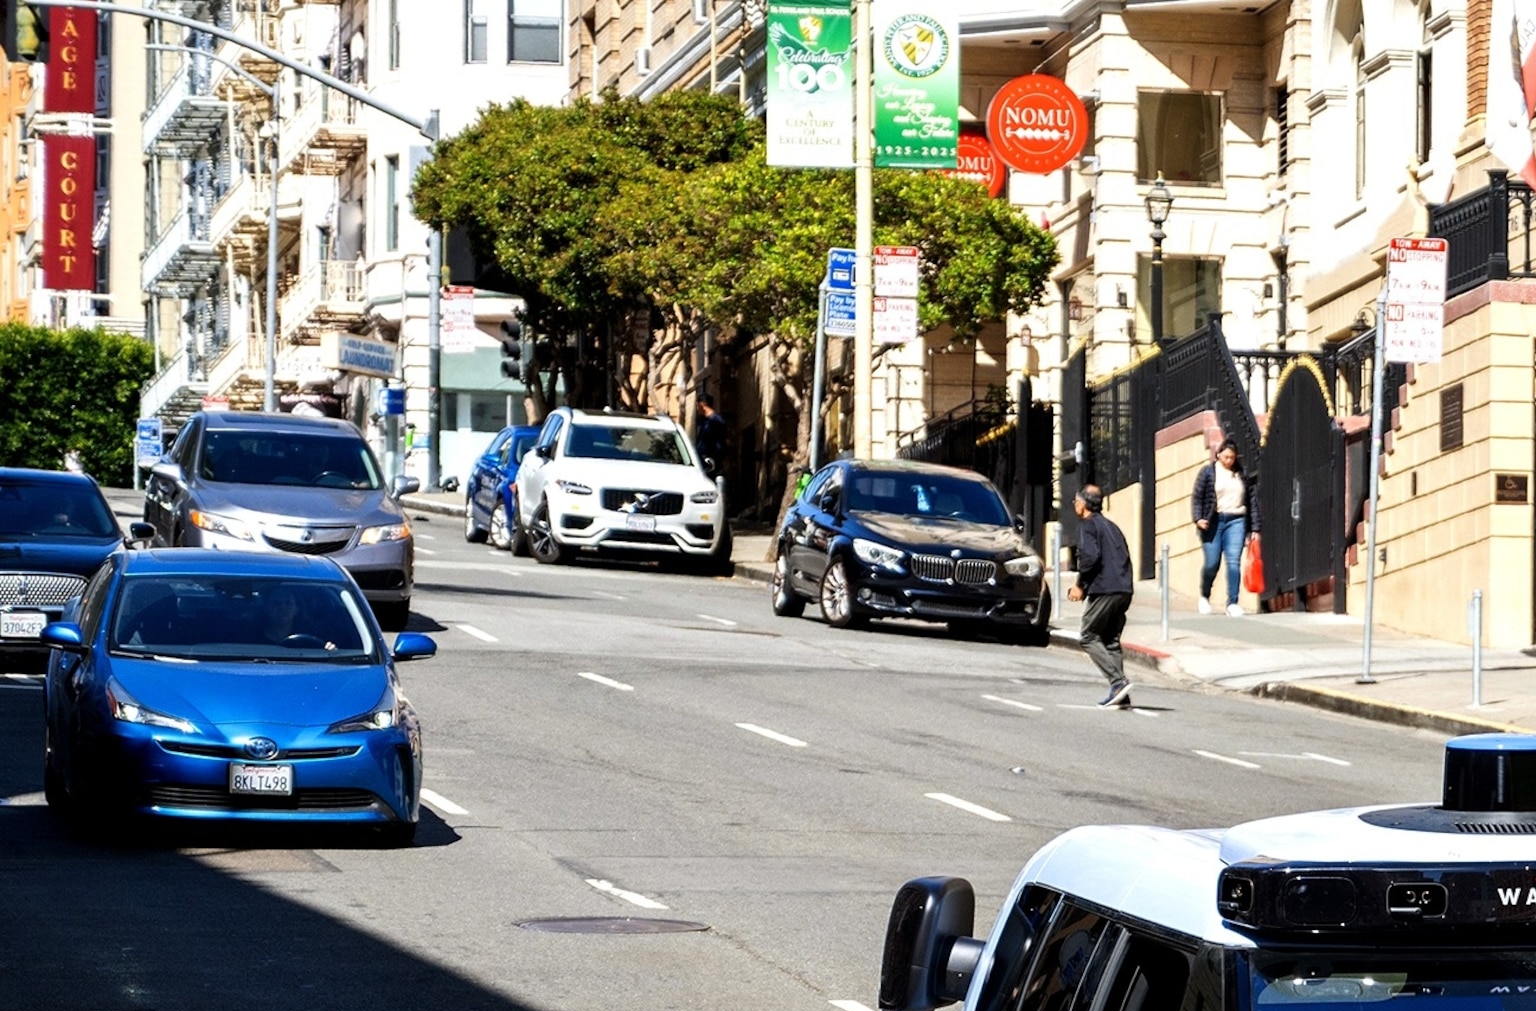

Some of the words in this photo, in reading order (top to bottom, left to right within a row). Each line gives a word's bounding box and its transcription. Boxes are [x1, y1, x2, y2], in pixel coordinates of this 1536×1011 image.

[60, 6, 79, 90] AGE
[780, 46, 844, 65] Celebrating
[774, 62, 846, 92] 100
[806, 110, 814, 118] A
[1005, 107, 1070, 127] NOMU
[786, 118, 835, 127] CENTURY
[803, 128, 816, 136] OF
[779, 136, 841, 145] EXCELLENCE
[876, 145, 956, 156] 1925-2025
[956, 156, 991, 171] OMU
[831, 252, 848, 264] Pay
[1390, 248, 1406, 261] NO
[1408, 252, 1443, 263] STOPPING
[829, 295, 845, 307] Pay
[829, 311, 849, 319] Plate
[1388, 305, 1403, 320] NO
[234, 775, 288, 790] 8KLT498
